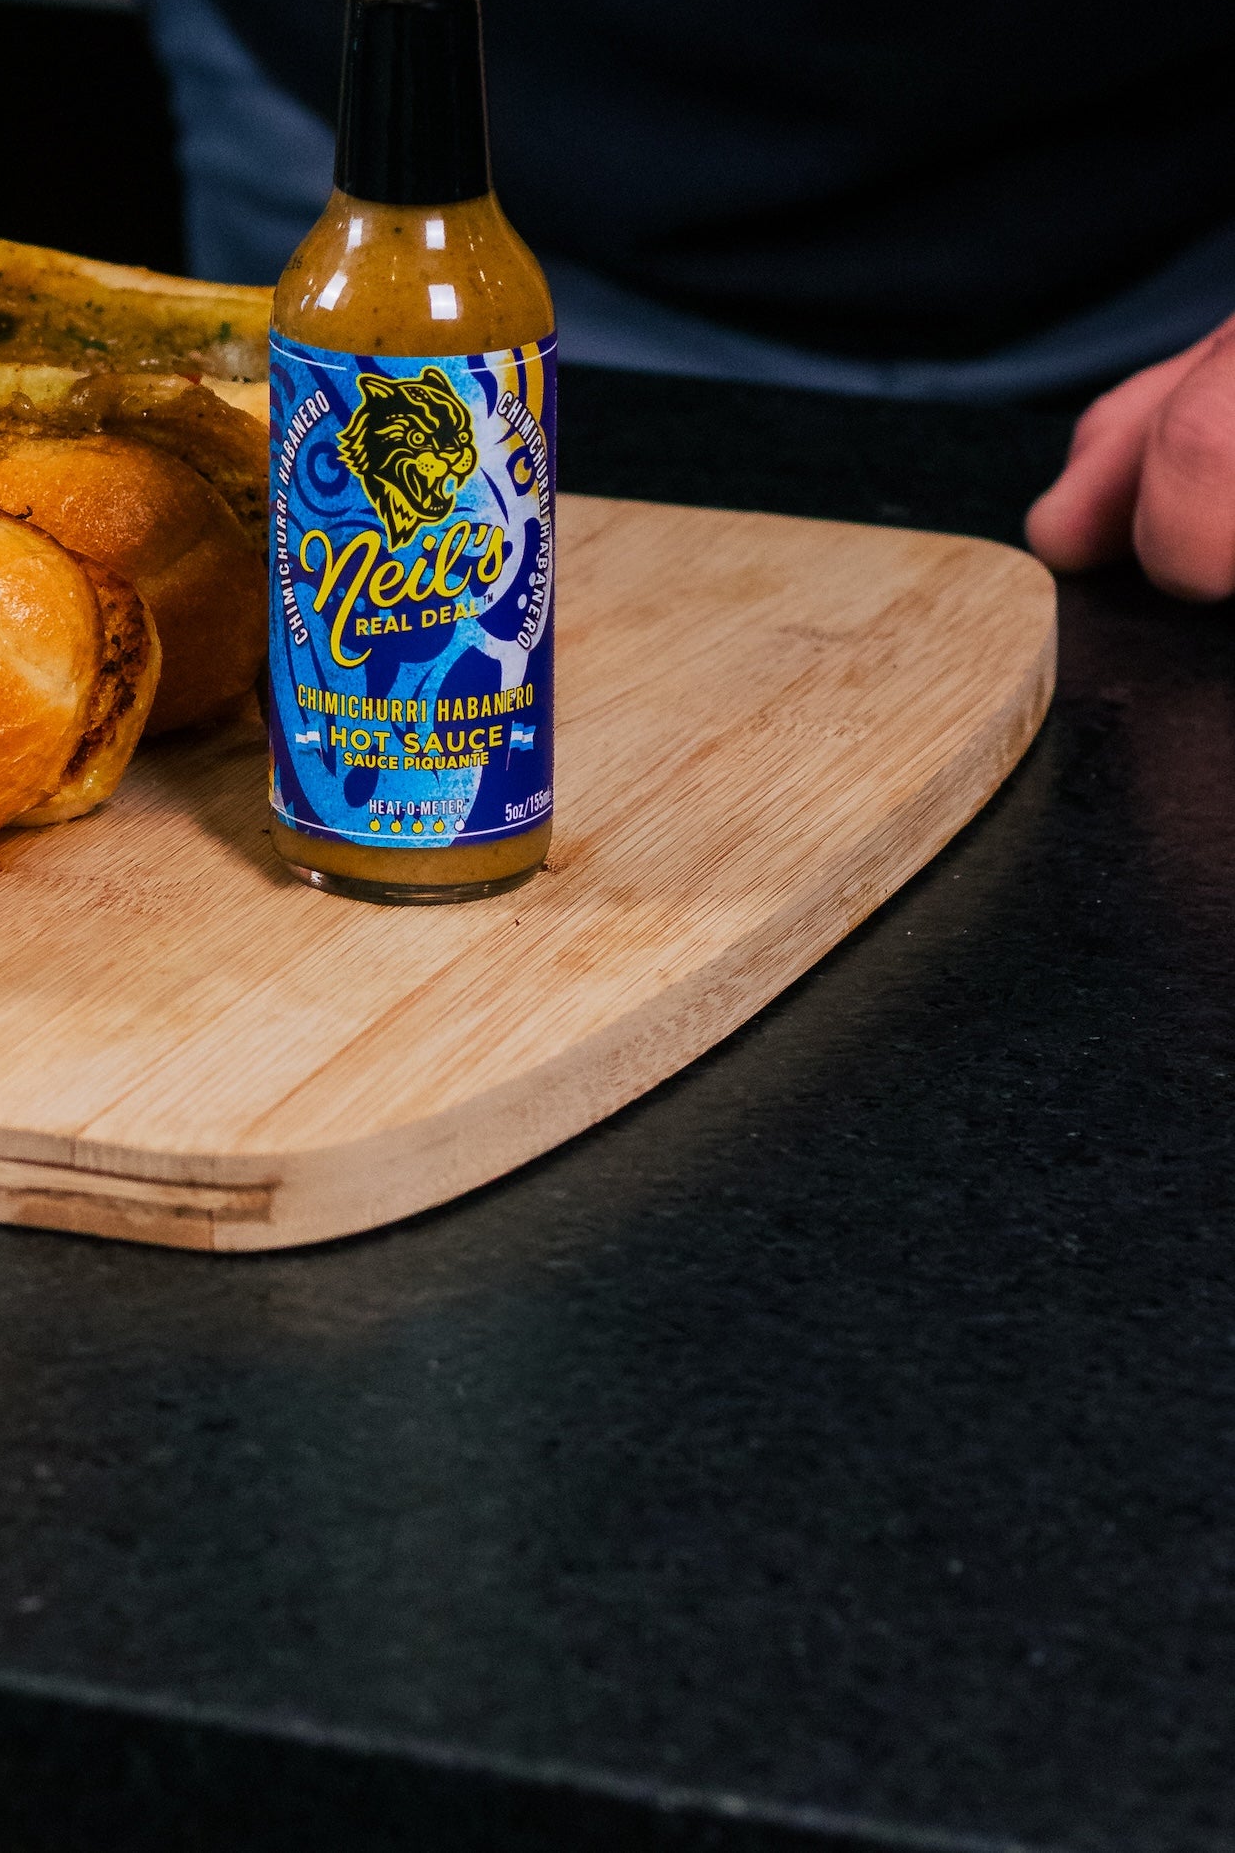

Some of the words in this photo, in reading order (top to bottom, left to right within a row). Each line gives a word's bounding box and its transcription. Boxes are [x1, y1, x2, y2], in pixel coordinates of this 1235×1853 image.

[278, 389, 330, 486] HABANERO
[496, 390, 550, 516] CHIMICHURRI
[276, 488, 309, 645] CHIMICHURRI
[299, 520, 504, 668] Neil's
[517, 520, 551, 650] HABANERO
[355, 613, 413, 637] REAL
[420, 599, 480, 629] DEAL
[297, 683, 427, 723] CHIMICHURRI
[437, 683, 534, 722] HABANERO
[330, 725, 391, 753] HOT
[403, 724, 504, 754] SAUCE
[343, 751, 399, 770] SAUCE
[403, 750, 490, 771] PIQUANTE
[368, 799, 464, 816] HEAT-O-METER
